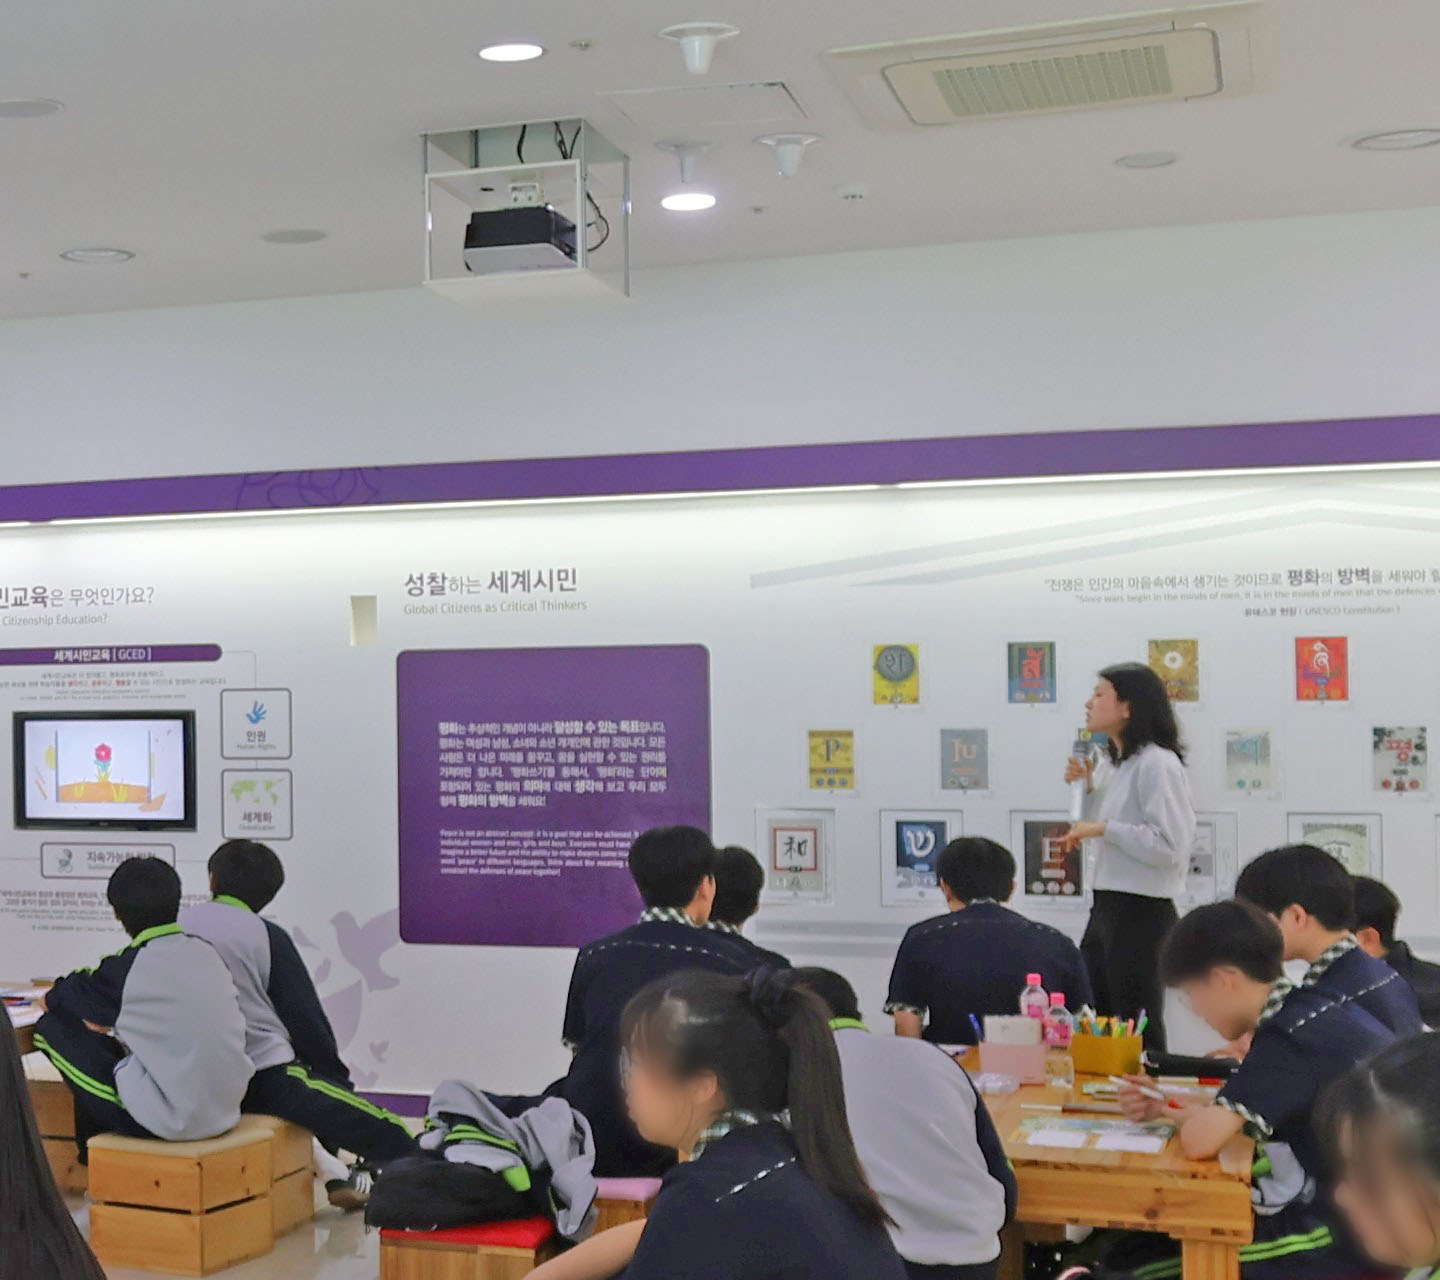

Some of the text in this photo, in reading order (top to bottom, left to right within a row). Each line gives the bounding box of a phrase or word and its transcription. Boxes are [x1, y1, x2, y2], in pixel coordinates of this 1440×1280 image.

[404, 567, 578, 597] 성찰하는 세계시민
[1089, 577, 1123, 590] 인간의
[1128, 576, 1189, 588] 마음속에서
[1193, 575, 1228, 588] 생기는
[1233, 574, 1281, 586] 것이므로
[1287, 569, 1333, 586] 평화의
[1337, 567, 1382, 586] 방벽을
[1389, 570, 1426, 583] 세워야
[69, 587, 154, 607] 무엇인가요?
[404, 600, 587, 615] Global Citizens as Critical Thinkers
[3, 614, 54, 628] Citizenship
[56, 613, 108, 625] Education?
[54, 649, 110, 663] 세계시민교육
[439, 721, 618, 735] 평화는 개념이 아니라 수 있는
[246, 730, 266, 743] 인권
[439, 738, 465, 749] 평화는
[457, 794, 487, 807] 평화의
[242, 811, 272, 824] 세계화
[784, 835, 808, 860] 和
